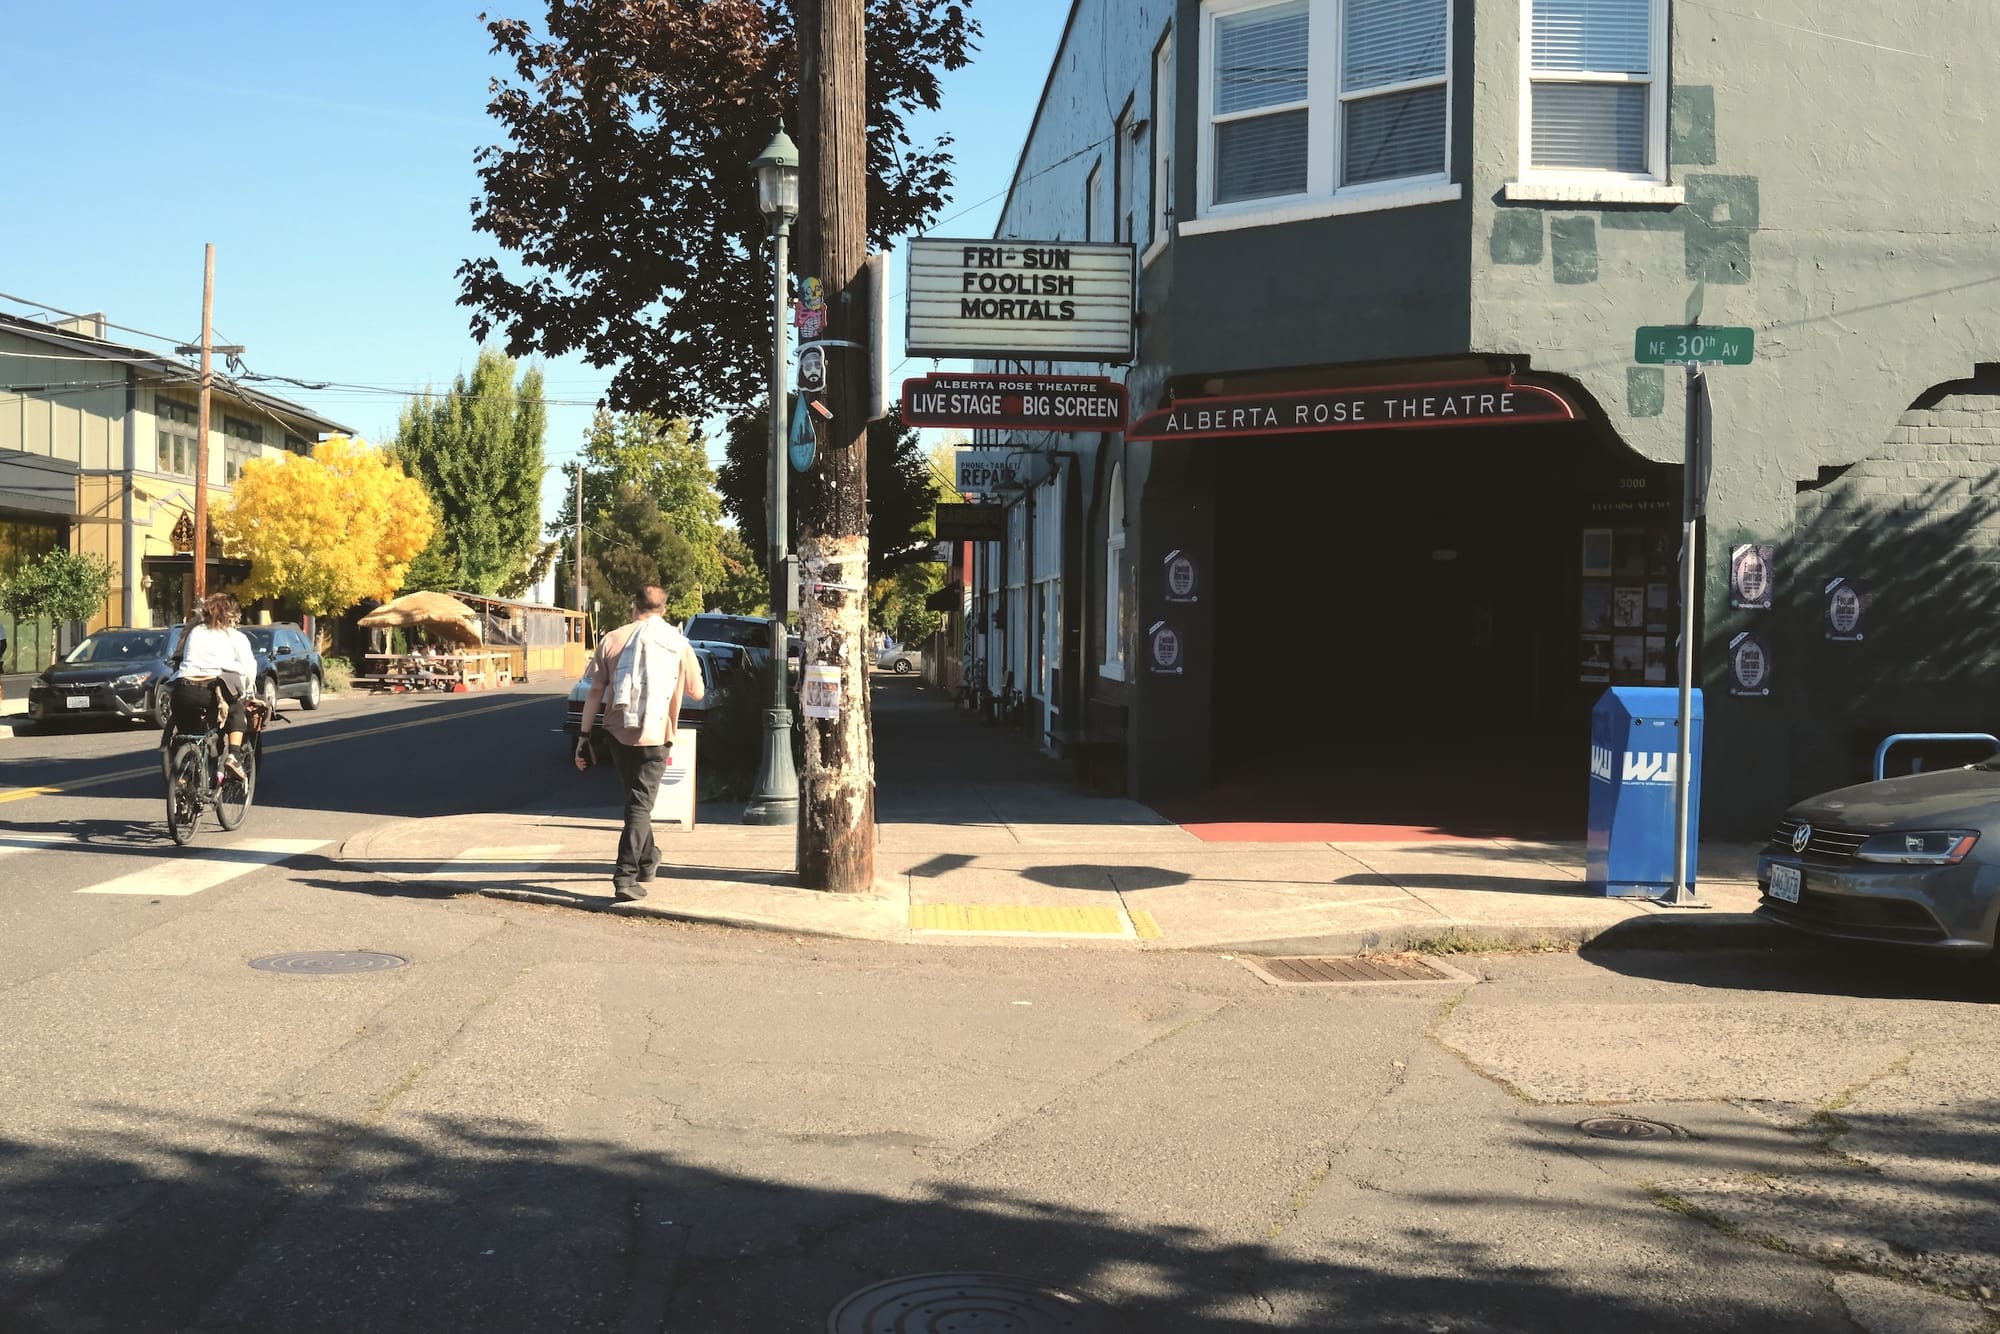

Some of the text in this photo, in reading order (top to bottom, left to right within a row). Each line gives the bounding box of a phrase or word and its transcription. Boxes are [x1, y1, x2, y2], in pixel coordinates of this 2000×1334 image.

[962, 272, 1075, 296] FOOLISH
[960, 298, 1076, 321] MORTALS
[1649, 341, 1666, 356] NE
[1675, 335, 1717, 357] 30th
[934, 380, 1098, 392] ALBERTA ROSE THEATRE
[912, 393, 1119, 418] LIVE STAGE BIG SCREEN
[1165, 393, 1515, 432] ALBERTA ROSE THEATRE
[960, 468, 1017, 487] REPAIR
[1619, 478, 1646, 489] 3000
